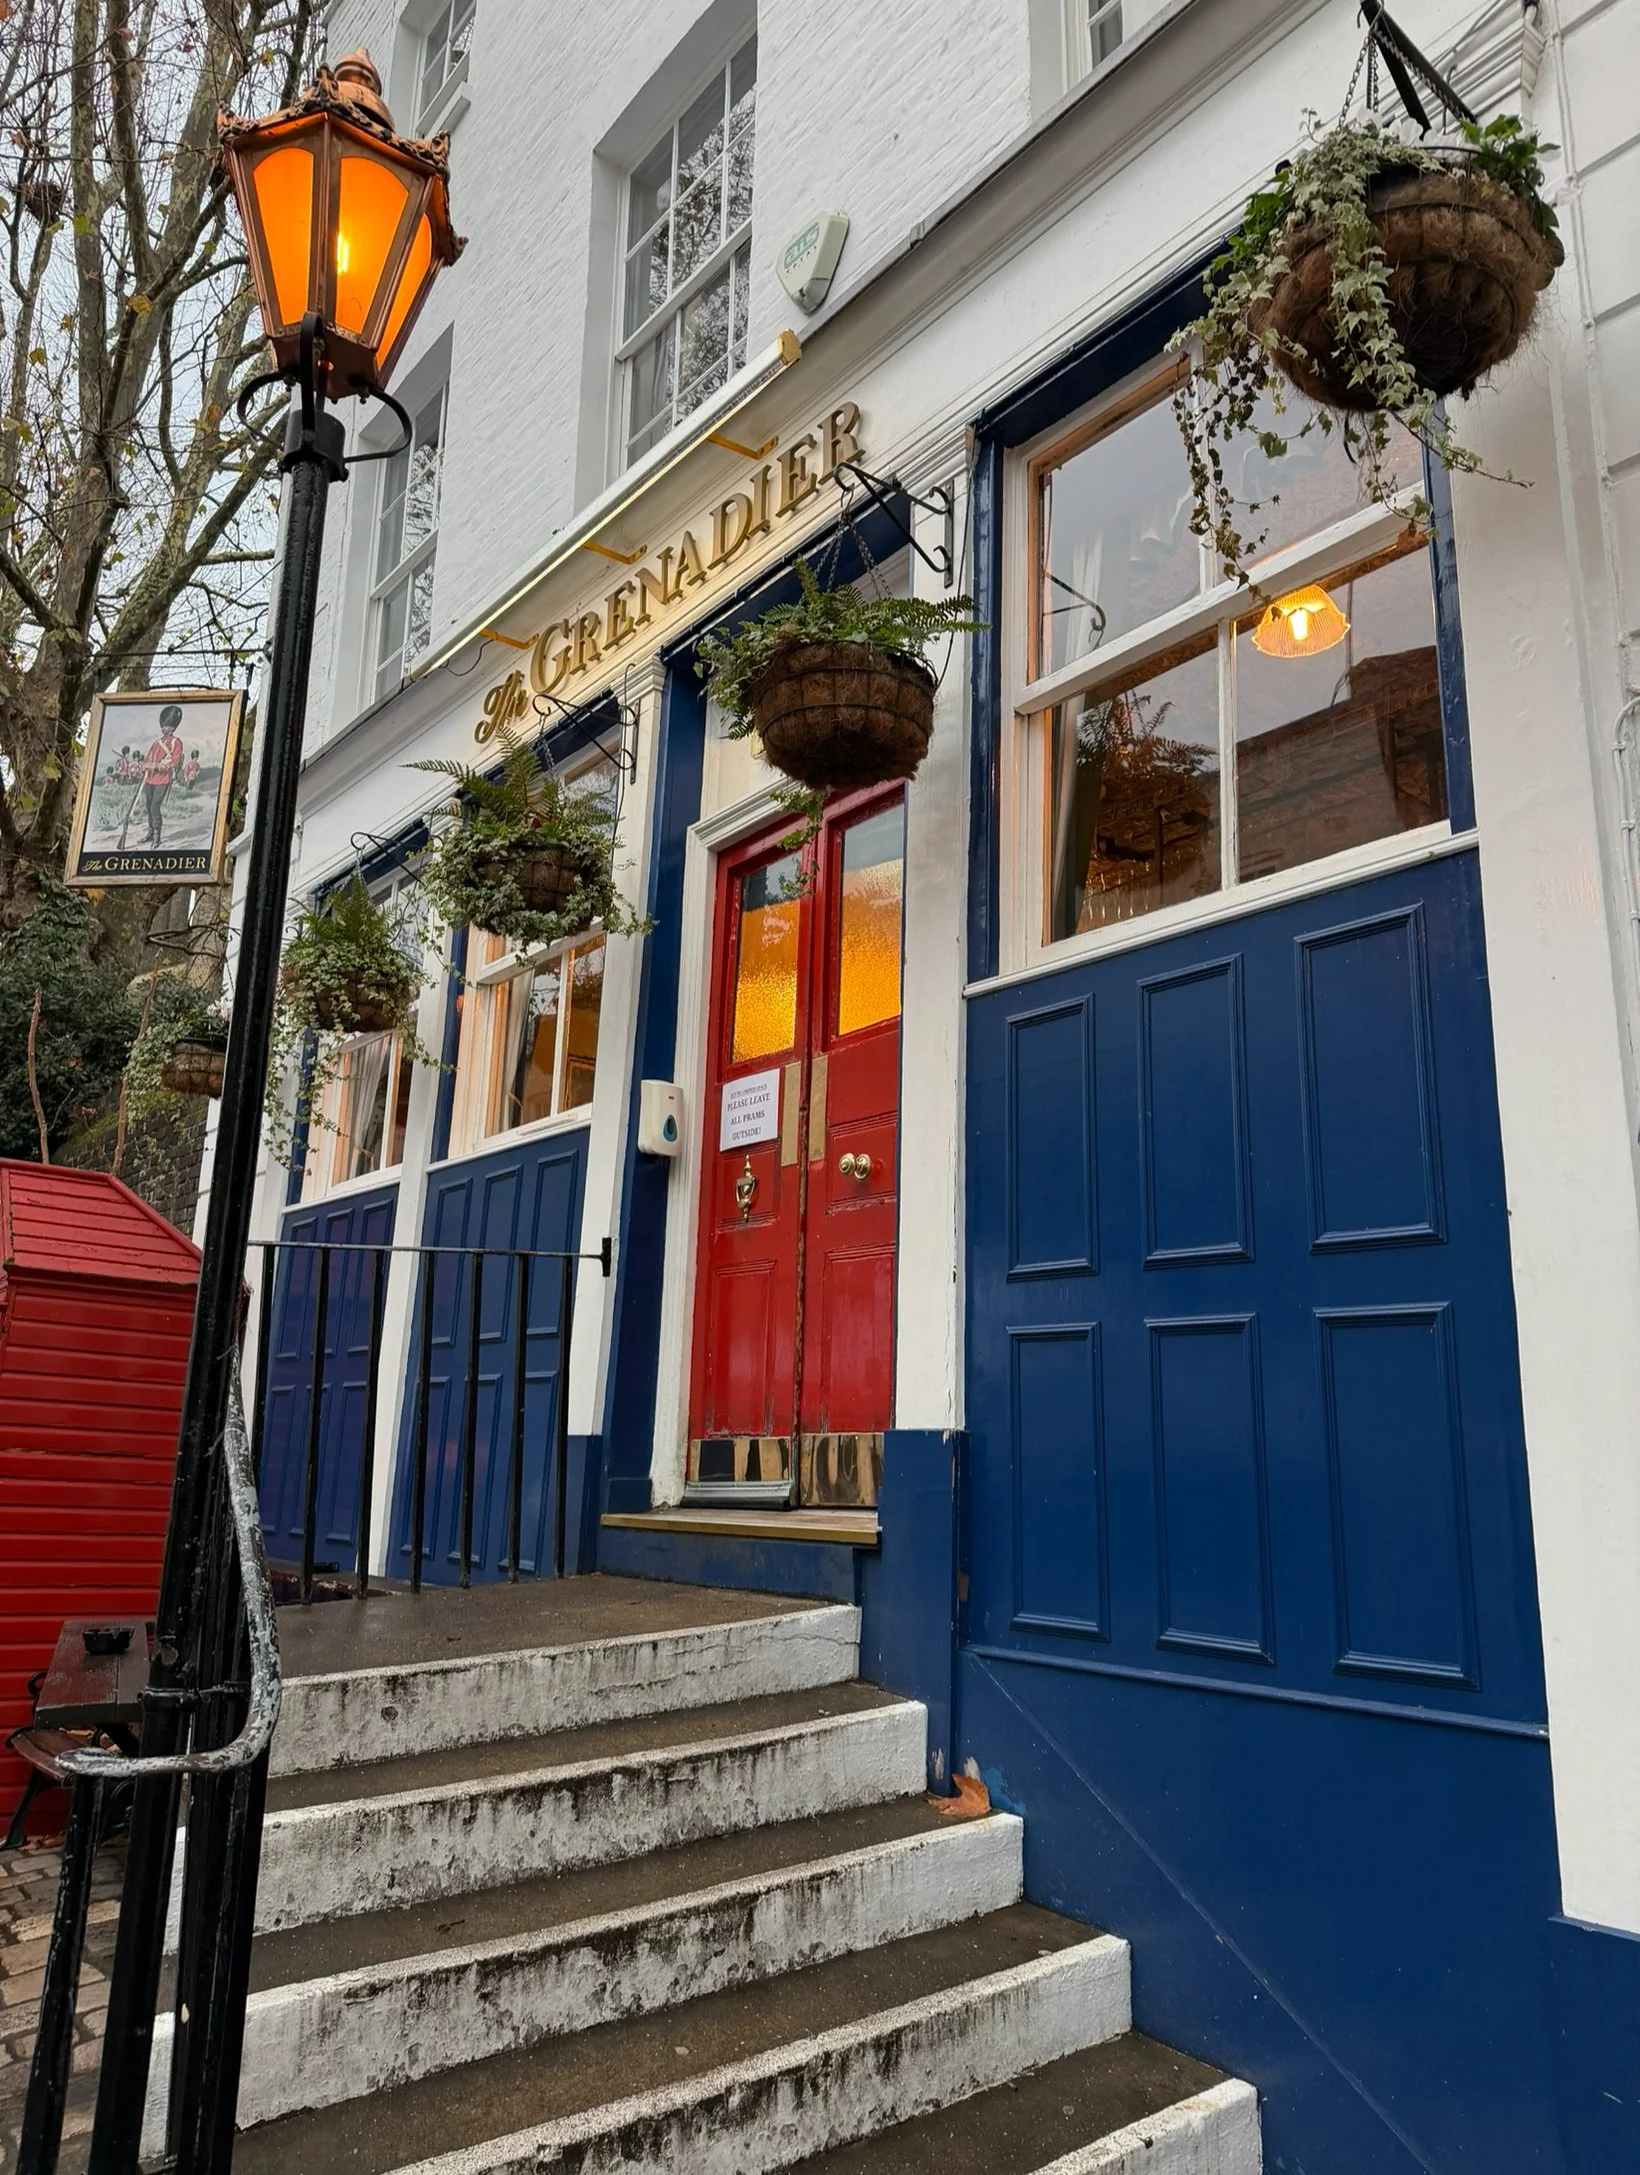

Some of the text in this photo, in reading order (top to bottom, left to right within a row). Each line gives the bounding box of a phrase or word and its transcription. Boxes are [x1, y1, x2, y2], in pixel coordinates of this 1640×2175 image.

[474, 401, 867, 744] The GRENADIER
[82, 856, 206, 872] The GRENADIER
[727, 1092, 770, 1111] PLEASE LEAVE
[731, 1110, 765, 1125] ALL PRAMS
